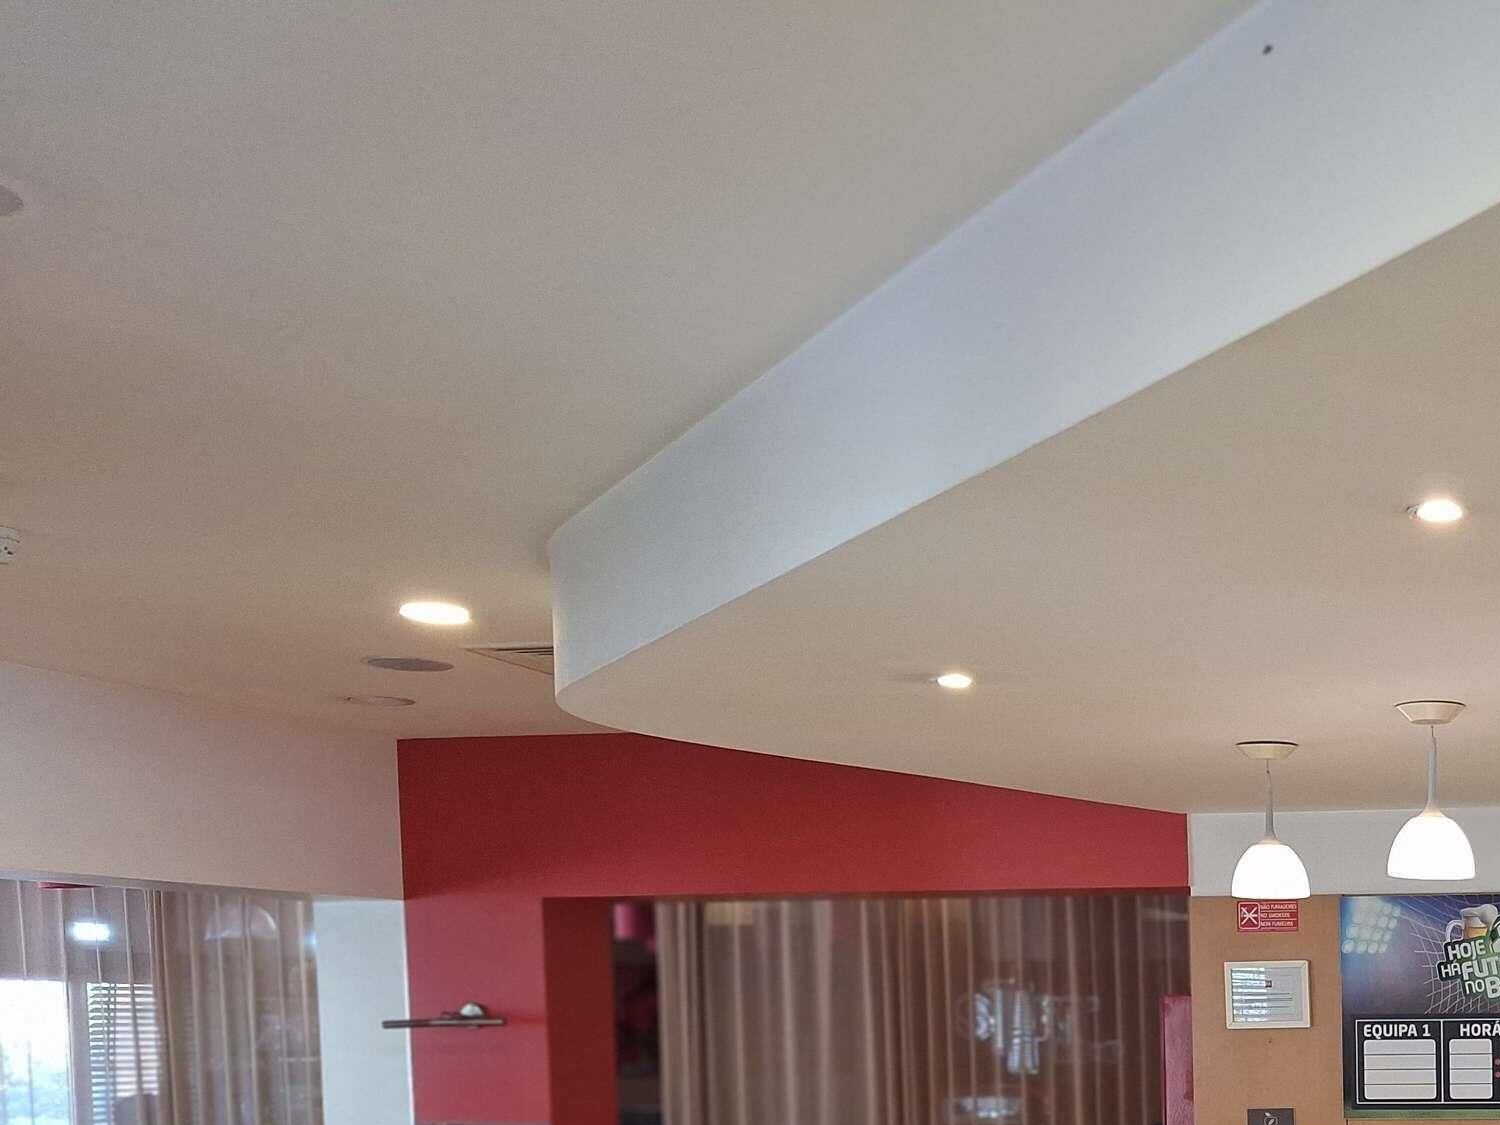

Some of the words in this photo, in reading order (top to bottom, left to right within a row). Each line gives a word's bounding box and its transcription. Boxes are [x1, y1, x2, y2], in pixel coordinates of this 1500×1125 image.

[1447, 940, 1486, 960] HOJE
[1441, 960, 1462, 978] HÁ
[1363, 1023, 1418, 1039] EQUIPA
[1422, 1024, 1431, 1037] 1
